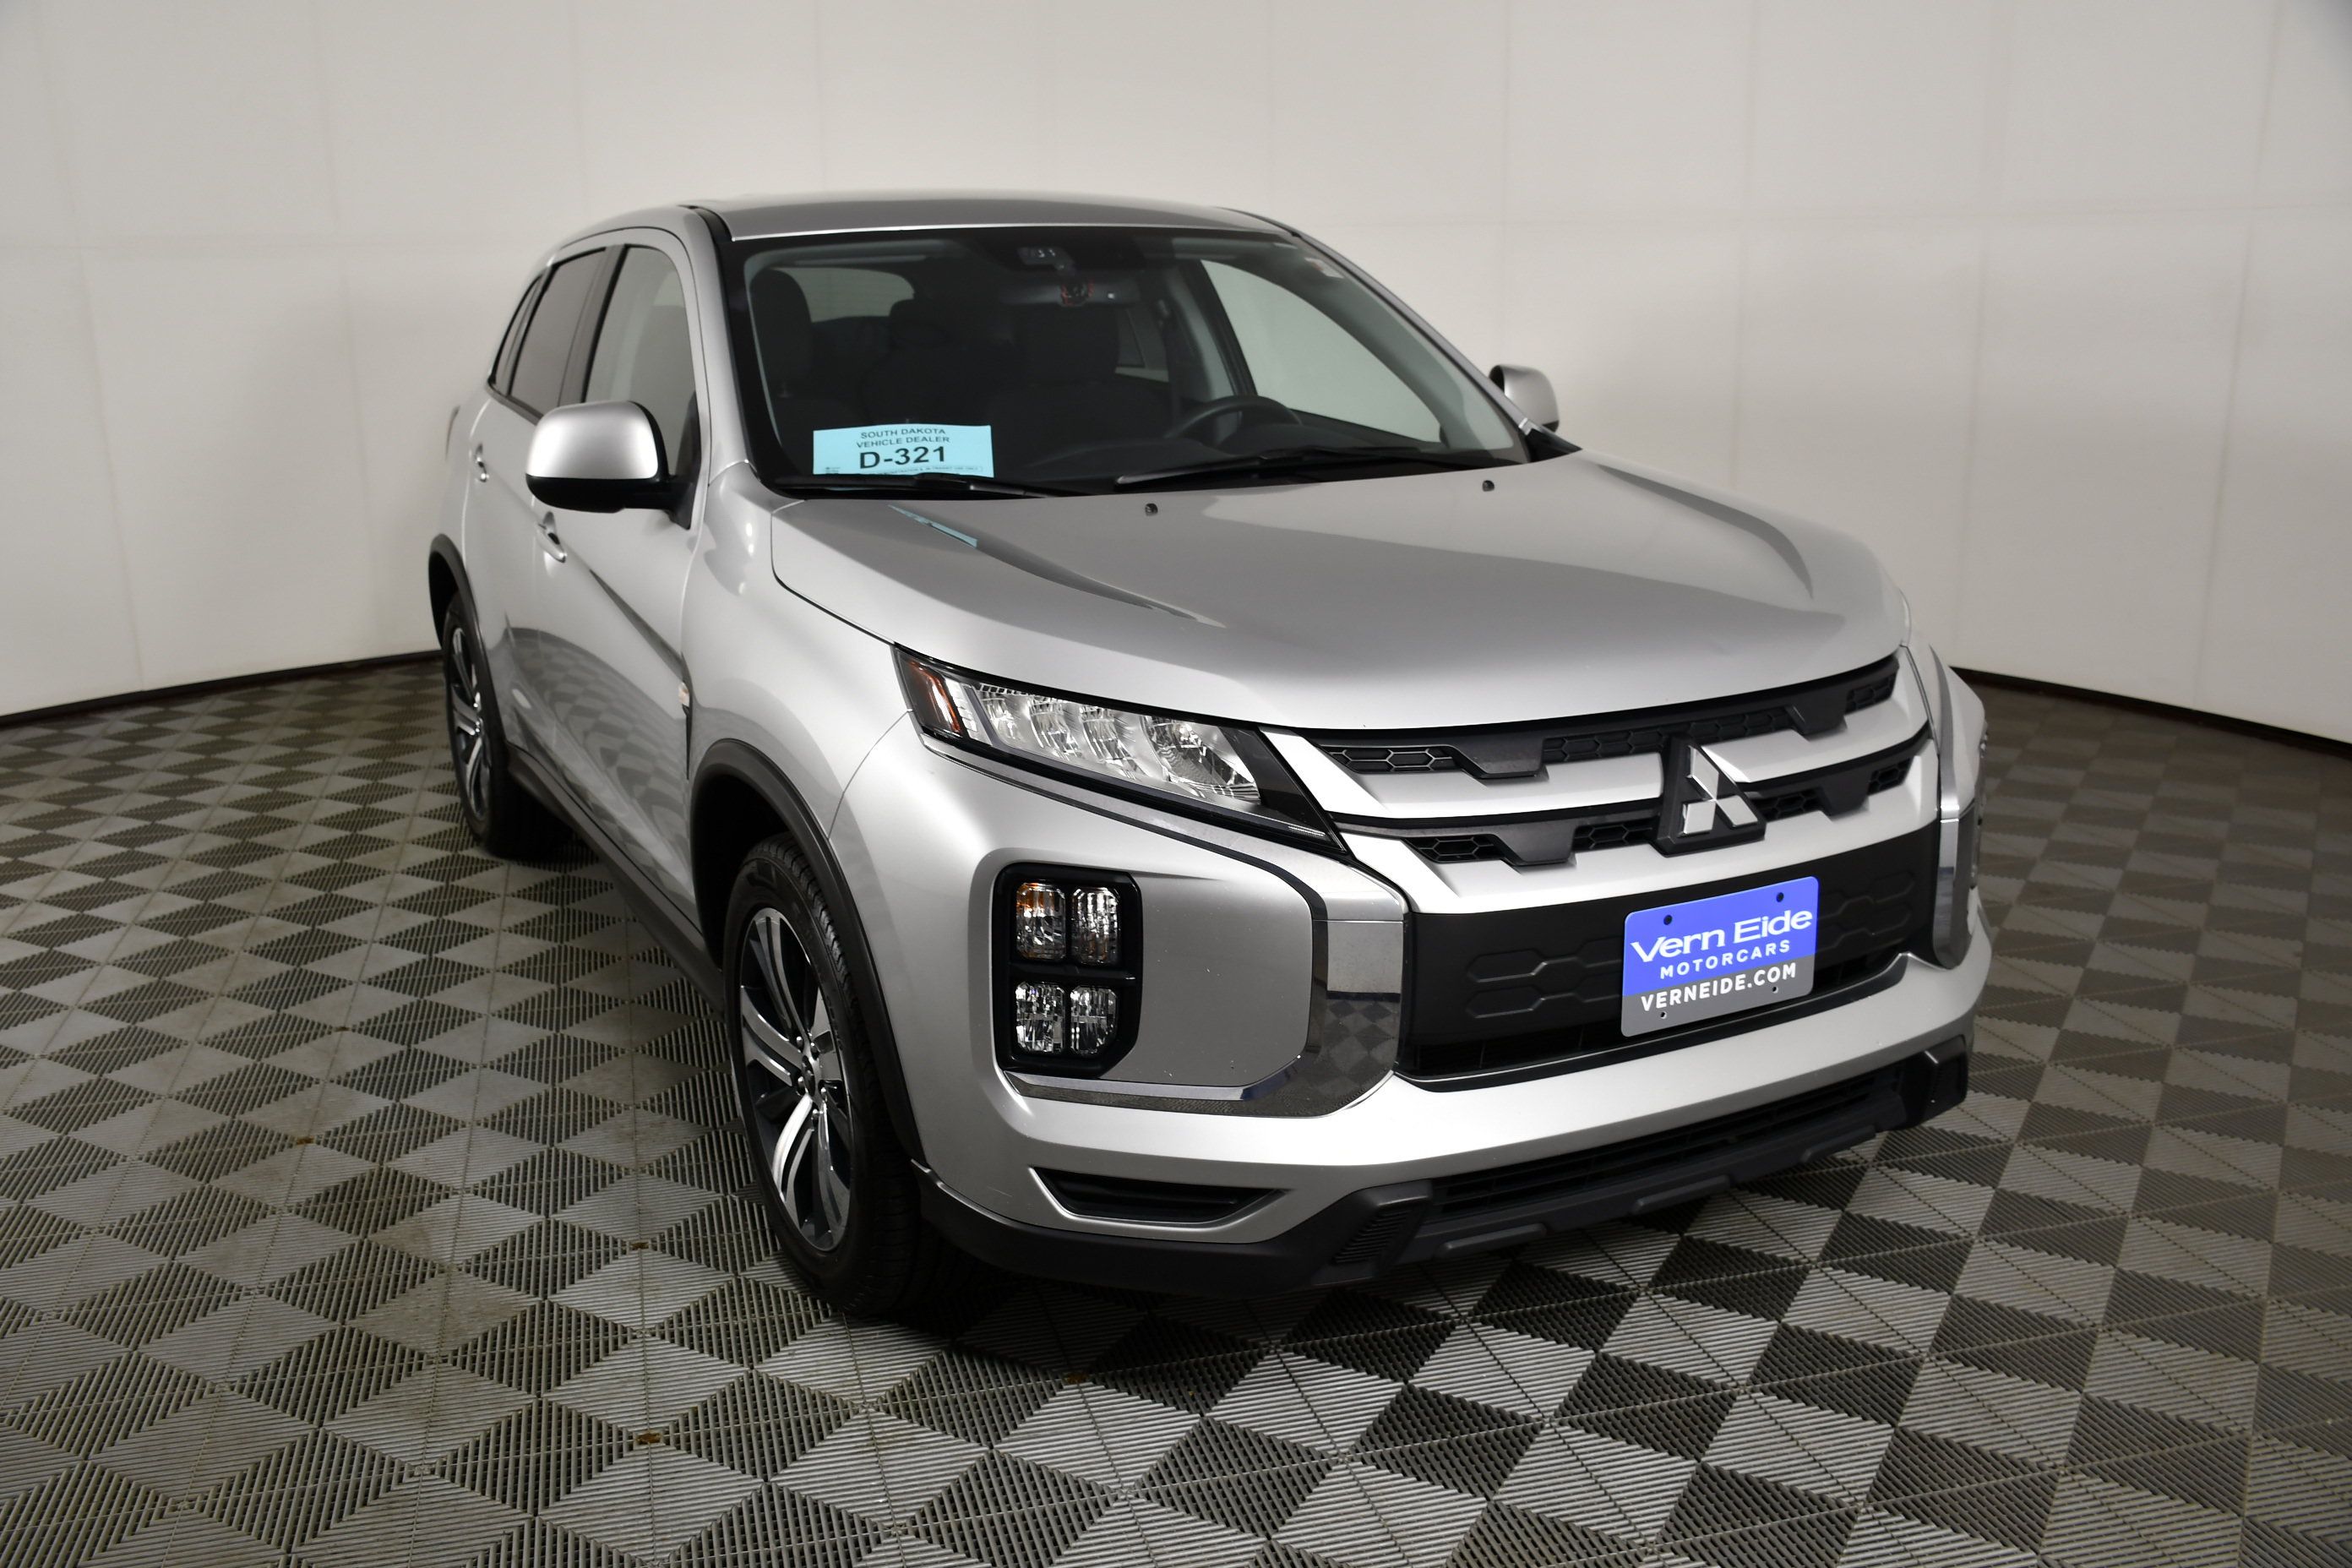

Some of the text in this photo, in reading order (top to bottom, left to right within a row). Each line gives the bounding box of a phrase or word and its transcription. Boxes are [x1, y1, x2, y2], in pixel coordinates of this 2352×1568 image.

[856, 438, 902, 448] VEHICLE
[861, 429, 897, 439] SOUTH
[859, 445, 945, 469] D-321
[1630, 909, 1814, 963] Vern Eide
[1660, 939, 1791, 980] MOTORCARS
[1641, 961, 1797, 1012] VERNEIDE.COM
